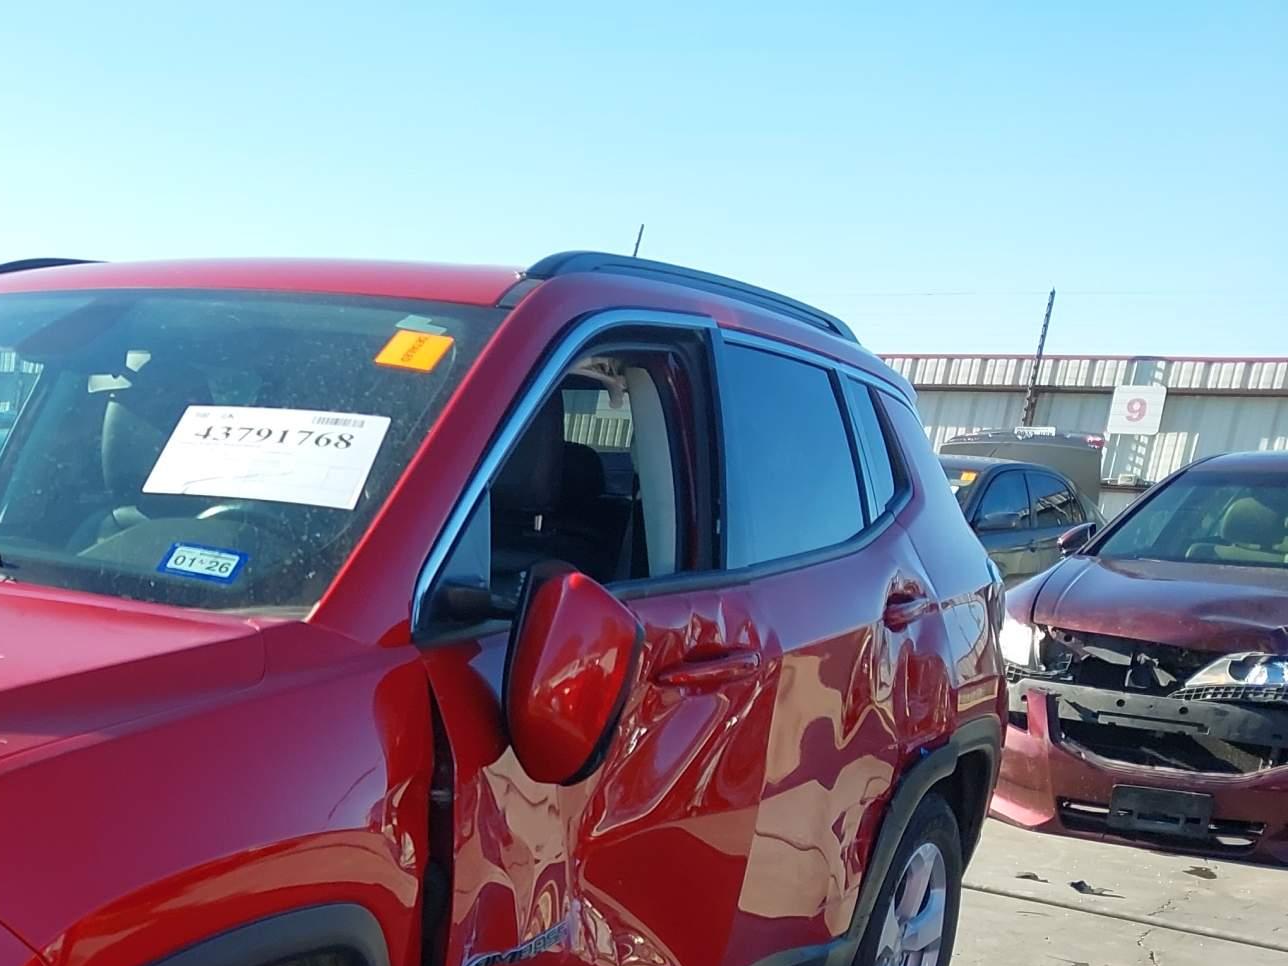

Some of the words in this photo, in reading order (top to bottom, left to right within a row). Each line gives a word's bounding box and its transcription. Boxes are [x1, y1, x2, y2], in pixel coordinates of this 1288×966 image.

[1125, 398, 1147, 422] 9
[194, 425, 355, 450] 43791768
[174, 555, 196, 568] 01
[205, 561, 231, 574] 26
